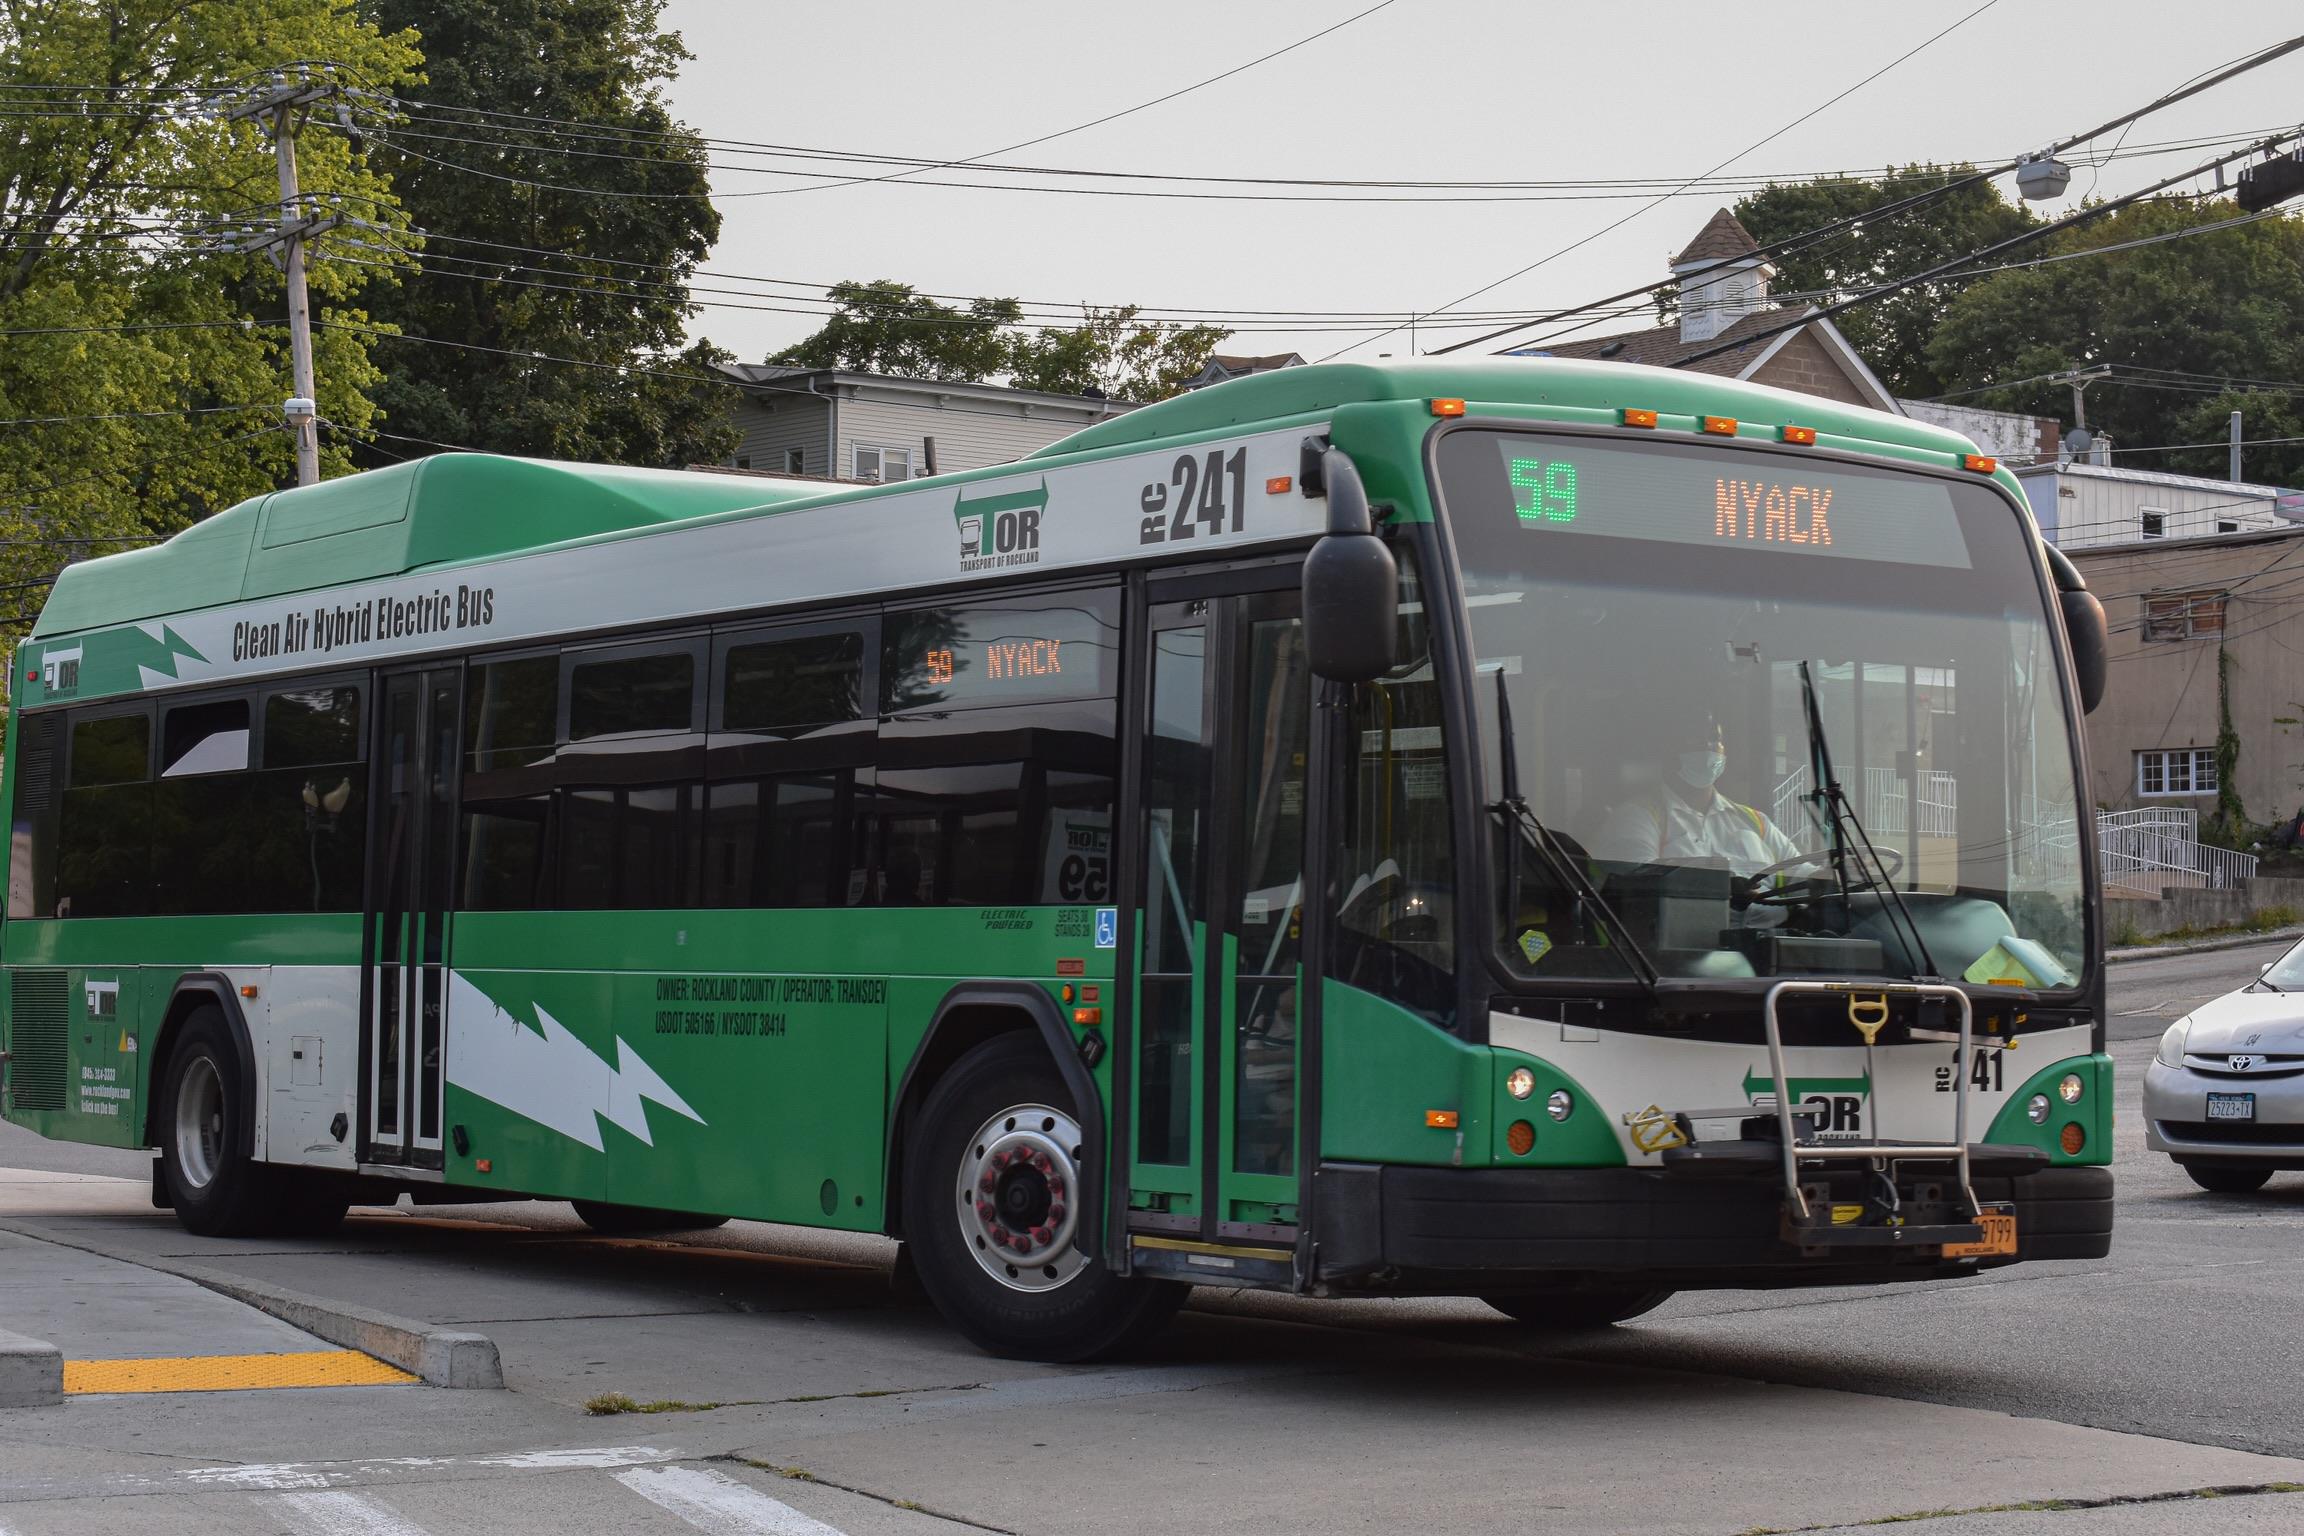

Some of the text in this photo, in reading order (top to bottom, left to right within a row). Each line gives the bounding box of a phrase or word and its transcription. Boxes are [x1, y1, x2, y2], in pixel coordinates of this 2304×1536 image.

[1140, 446, 1247, 545] RC 241
[1511, 458, 1832, 545] 59 NYACK
[953, 473, 1050, 556] TOR
[960, 551, 1039, 572] TRANSPORT OF ROCKLAND
[233, 584, 494, 662] Clean Air Hybrid Electric Bus
[927, 639, 1061, 686] 59 NYACK
[980, 910, 1027, 920] ELECTRIC
[985, 920, 1033, 930] POWERED
[1058, 909, 1079, 923] SEATS
[1056, 923, 1081, 937] STANDS
[656, 978, 690, 1001] OWNER:
[692, 978, 737, 1002] ROCKLAND
[740, 979, 776, 1002] COUNTY
[783, 979, 834, 1003] OPERATOR:
[837, 980, 888, 1004] TRANSDEV
[655, 1011, 683, 1034] USDOT
[722, 1012, 758, 1036] NYSDOT
[759, 1013, 786, 1036] 38414
[1935, 1066, 1950, 1092] RC
